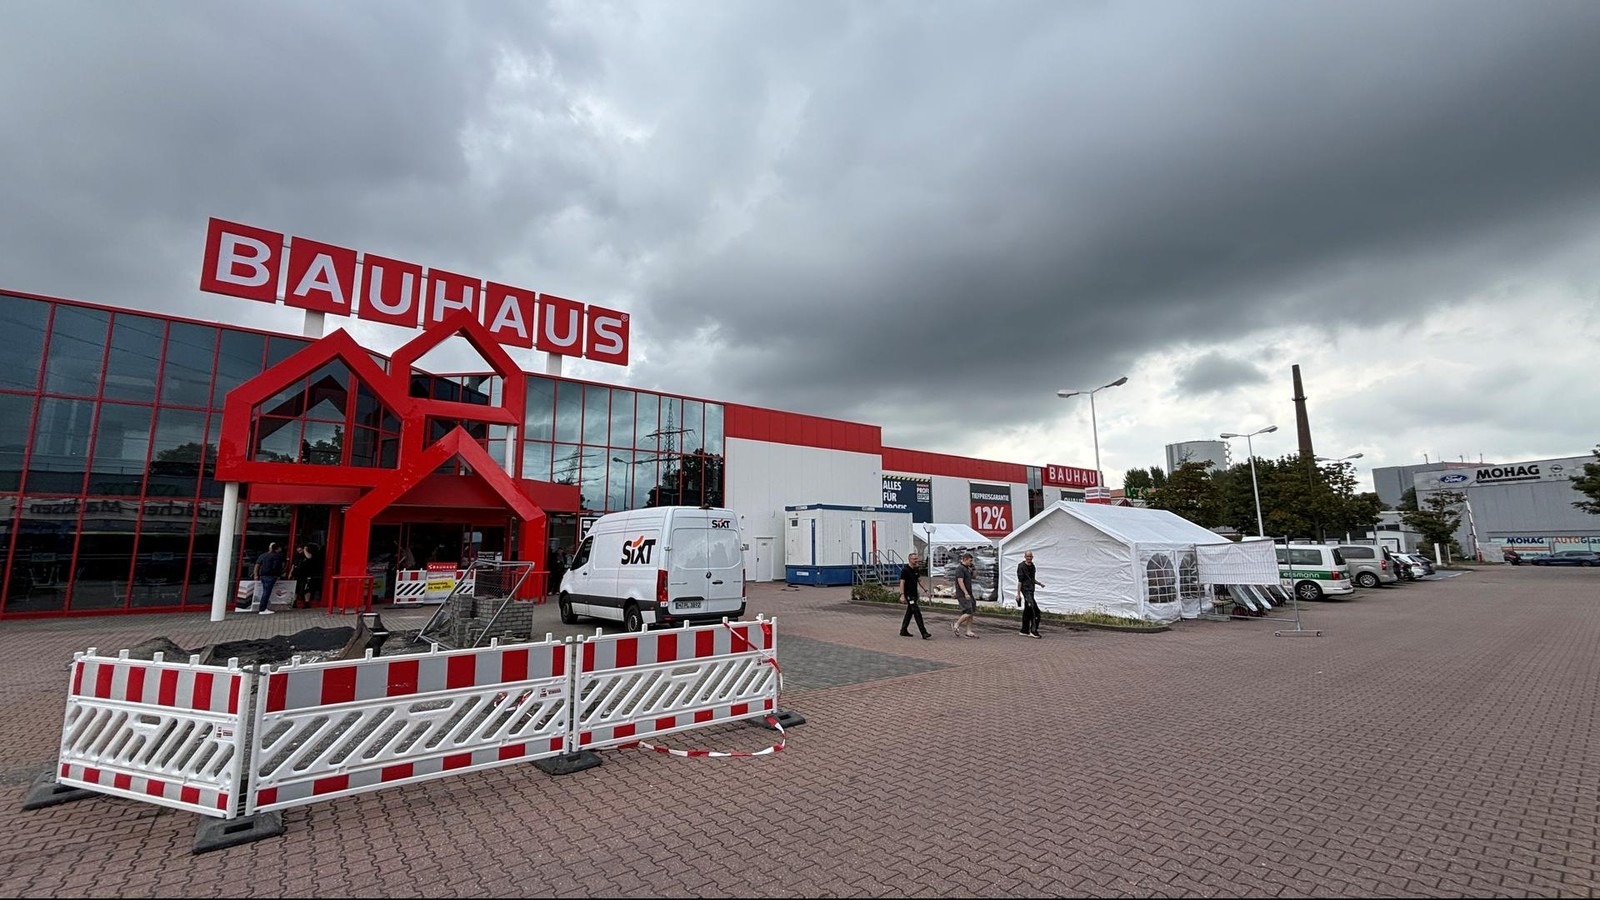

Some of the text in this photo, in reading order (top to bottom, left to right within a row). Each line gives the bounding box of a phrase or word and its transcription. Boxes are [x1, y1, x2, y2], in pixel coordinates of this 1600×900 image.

[215, 231, 625, 356] BAUHAUS
[1049, 466, 1101, 485] BAUHAU
[1444, 475, 1463, 483] Ford
[1476, 465, 1540, 480] MOHAG
[883, 480, 902, 491] ALLES
[883, 490, 897, 502] FÜR
[974, 505, 1007, 530] 12%
